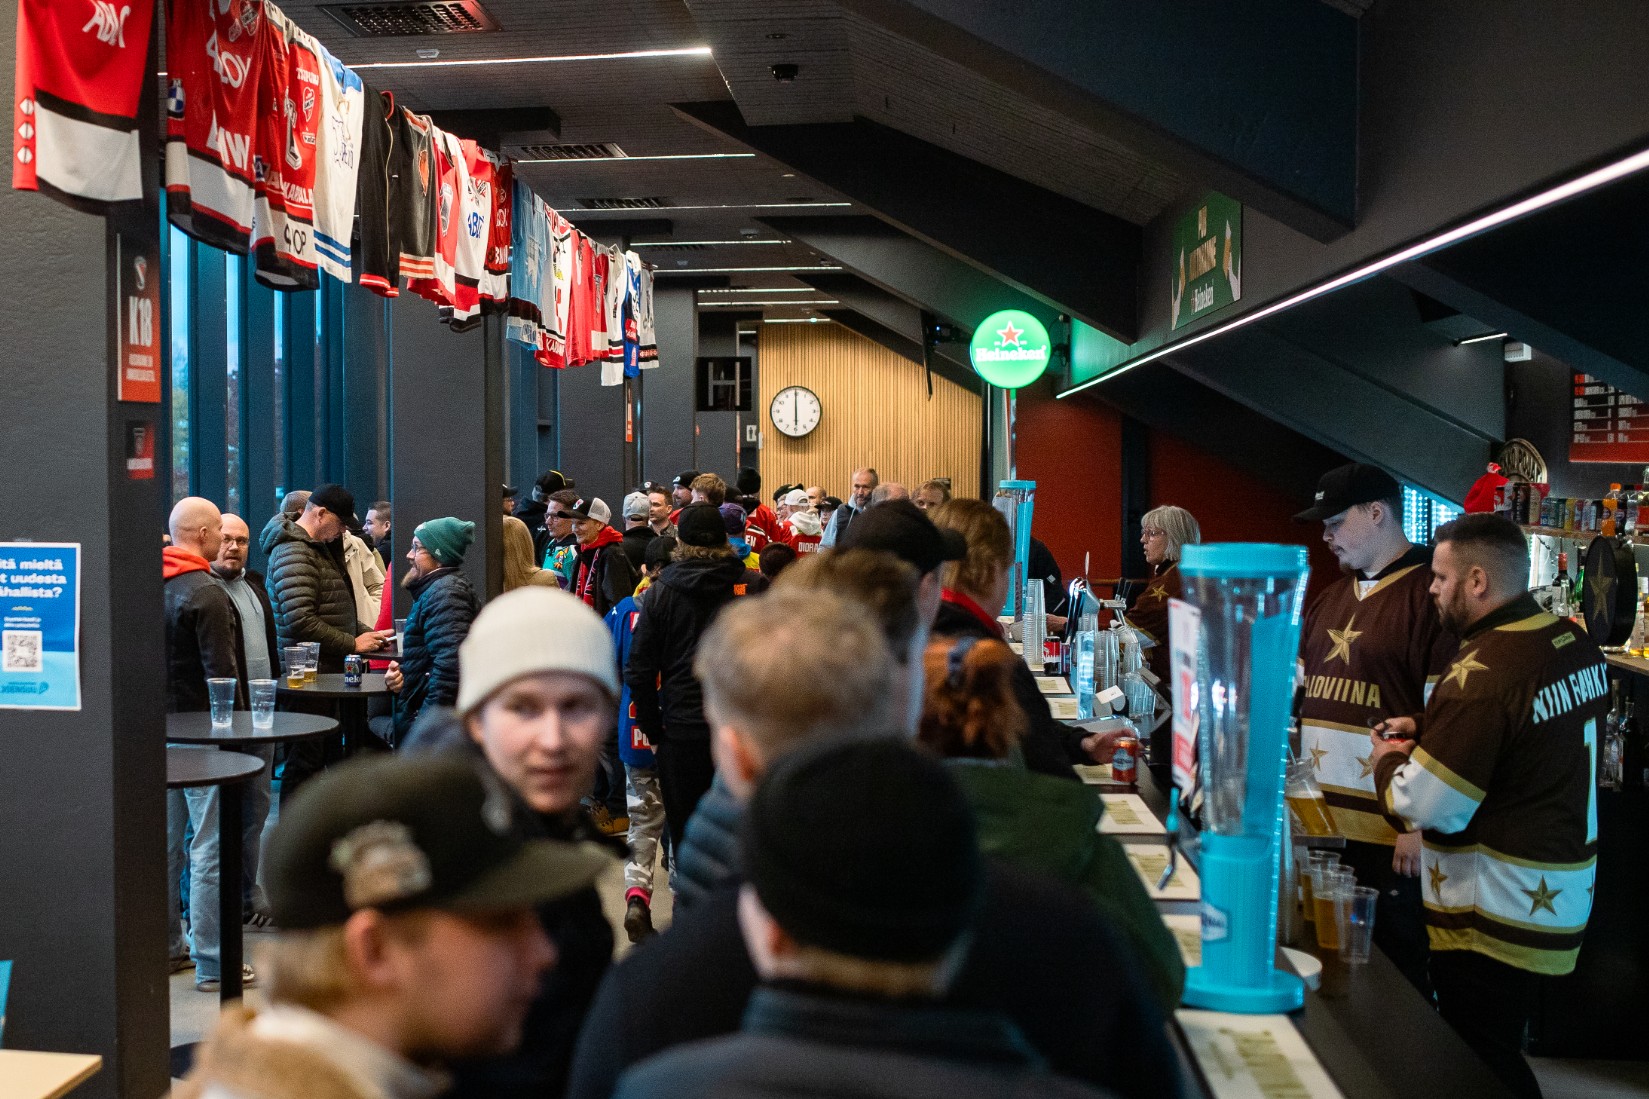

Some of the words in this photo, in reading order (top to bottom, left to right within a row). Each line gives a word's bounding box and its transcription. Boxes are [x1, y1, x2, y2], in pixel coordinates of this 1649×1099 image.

[975, 346, 1046, 361] Heineken
[0, 558, 17, 570] tä
[20, 558, 63, 570] mieltä
[11, 572, 67, 584] uudesta
[1583, 717, 1598, 845] 1
